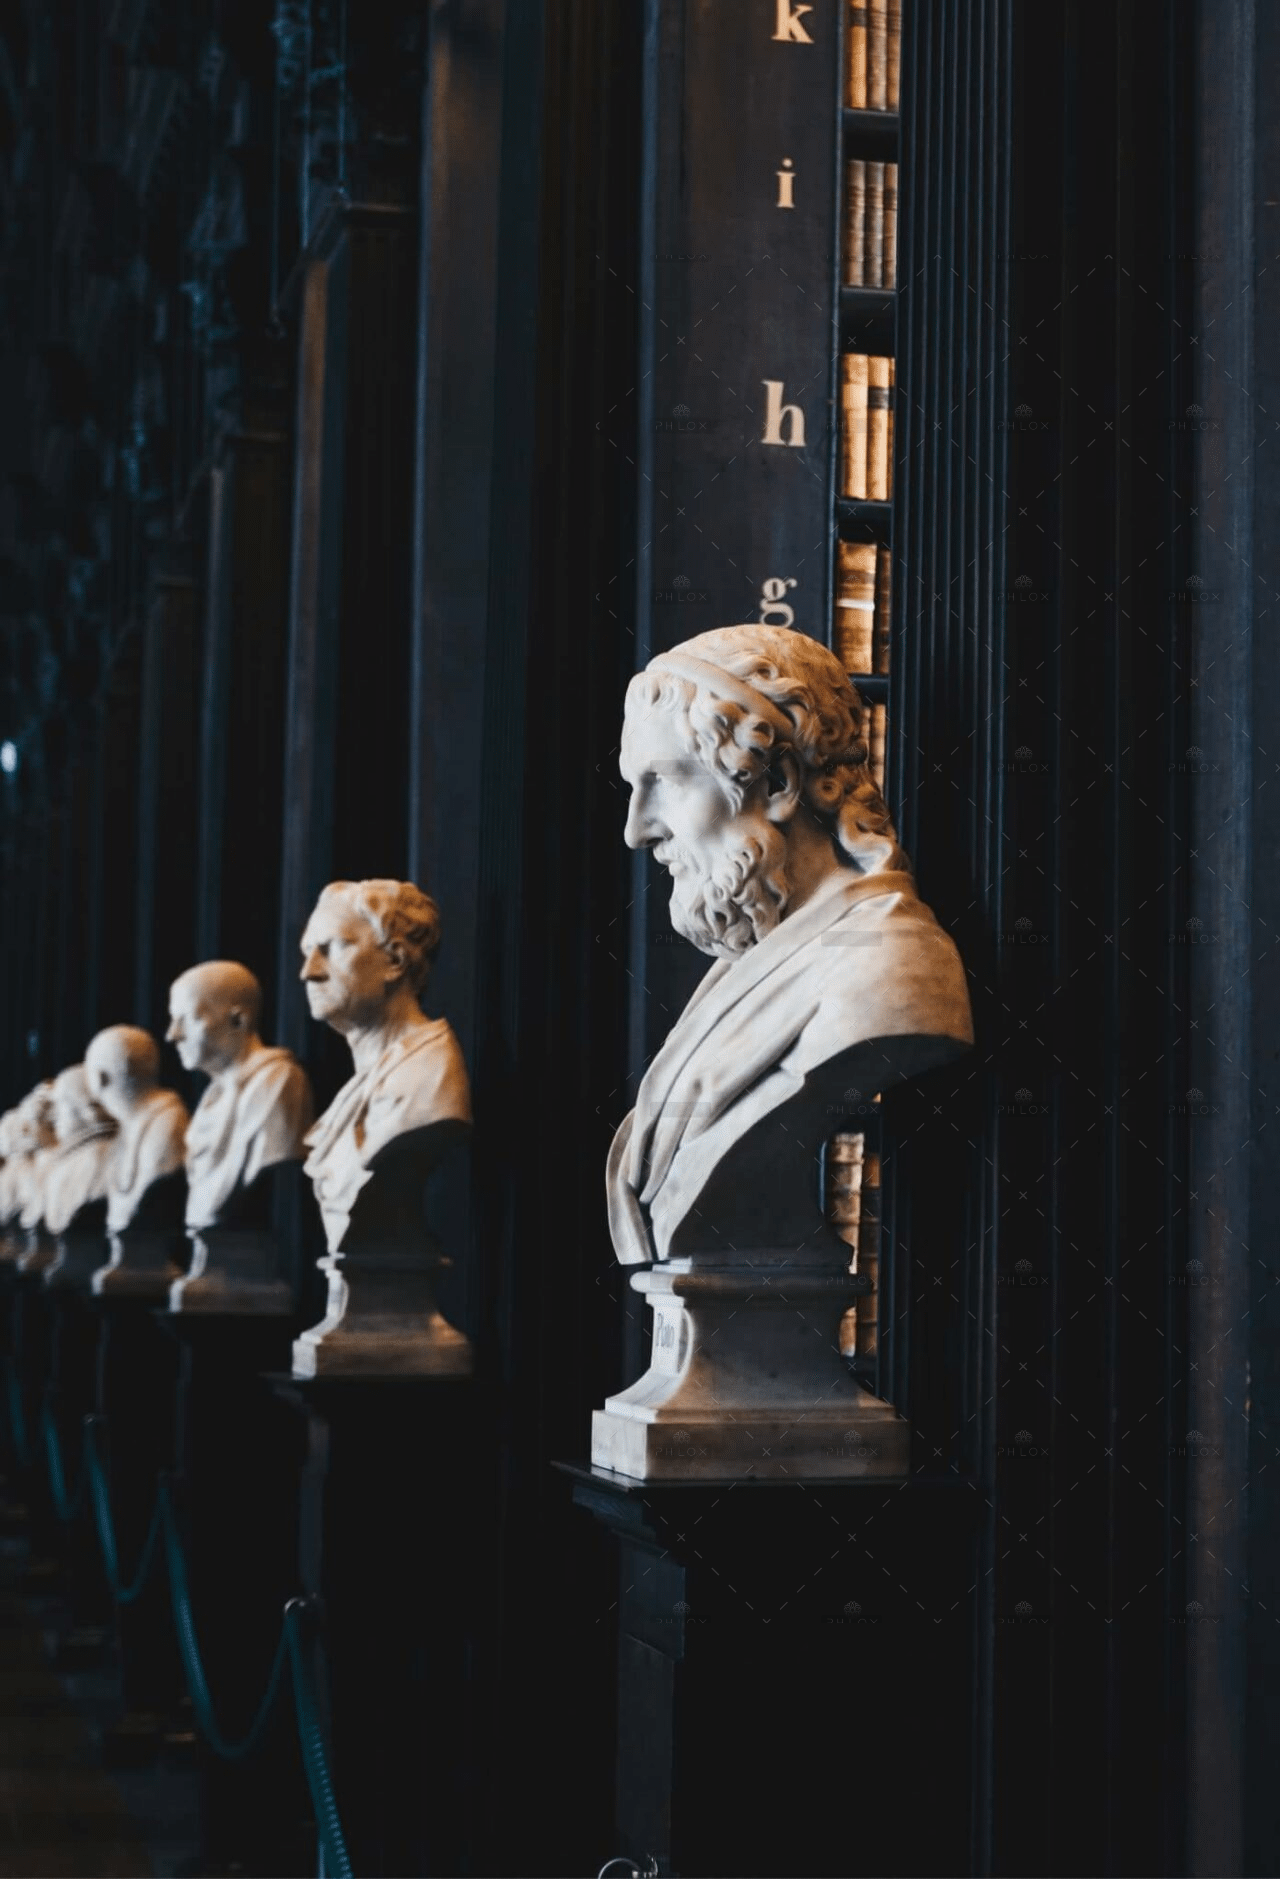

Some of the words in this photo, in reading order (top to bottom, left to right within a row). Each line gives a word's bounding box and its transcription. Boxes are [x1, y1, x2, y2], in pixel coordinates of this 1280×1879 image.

[772, 0, 813, 44] k
[775, 157, 796, 208] i
[761, 380, 807, 447] h
[758, 576, 798, 629] g
